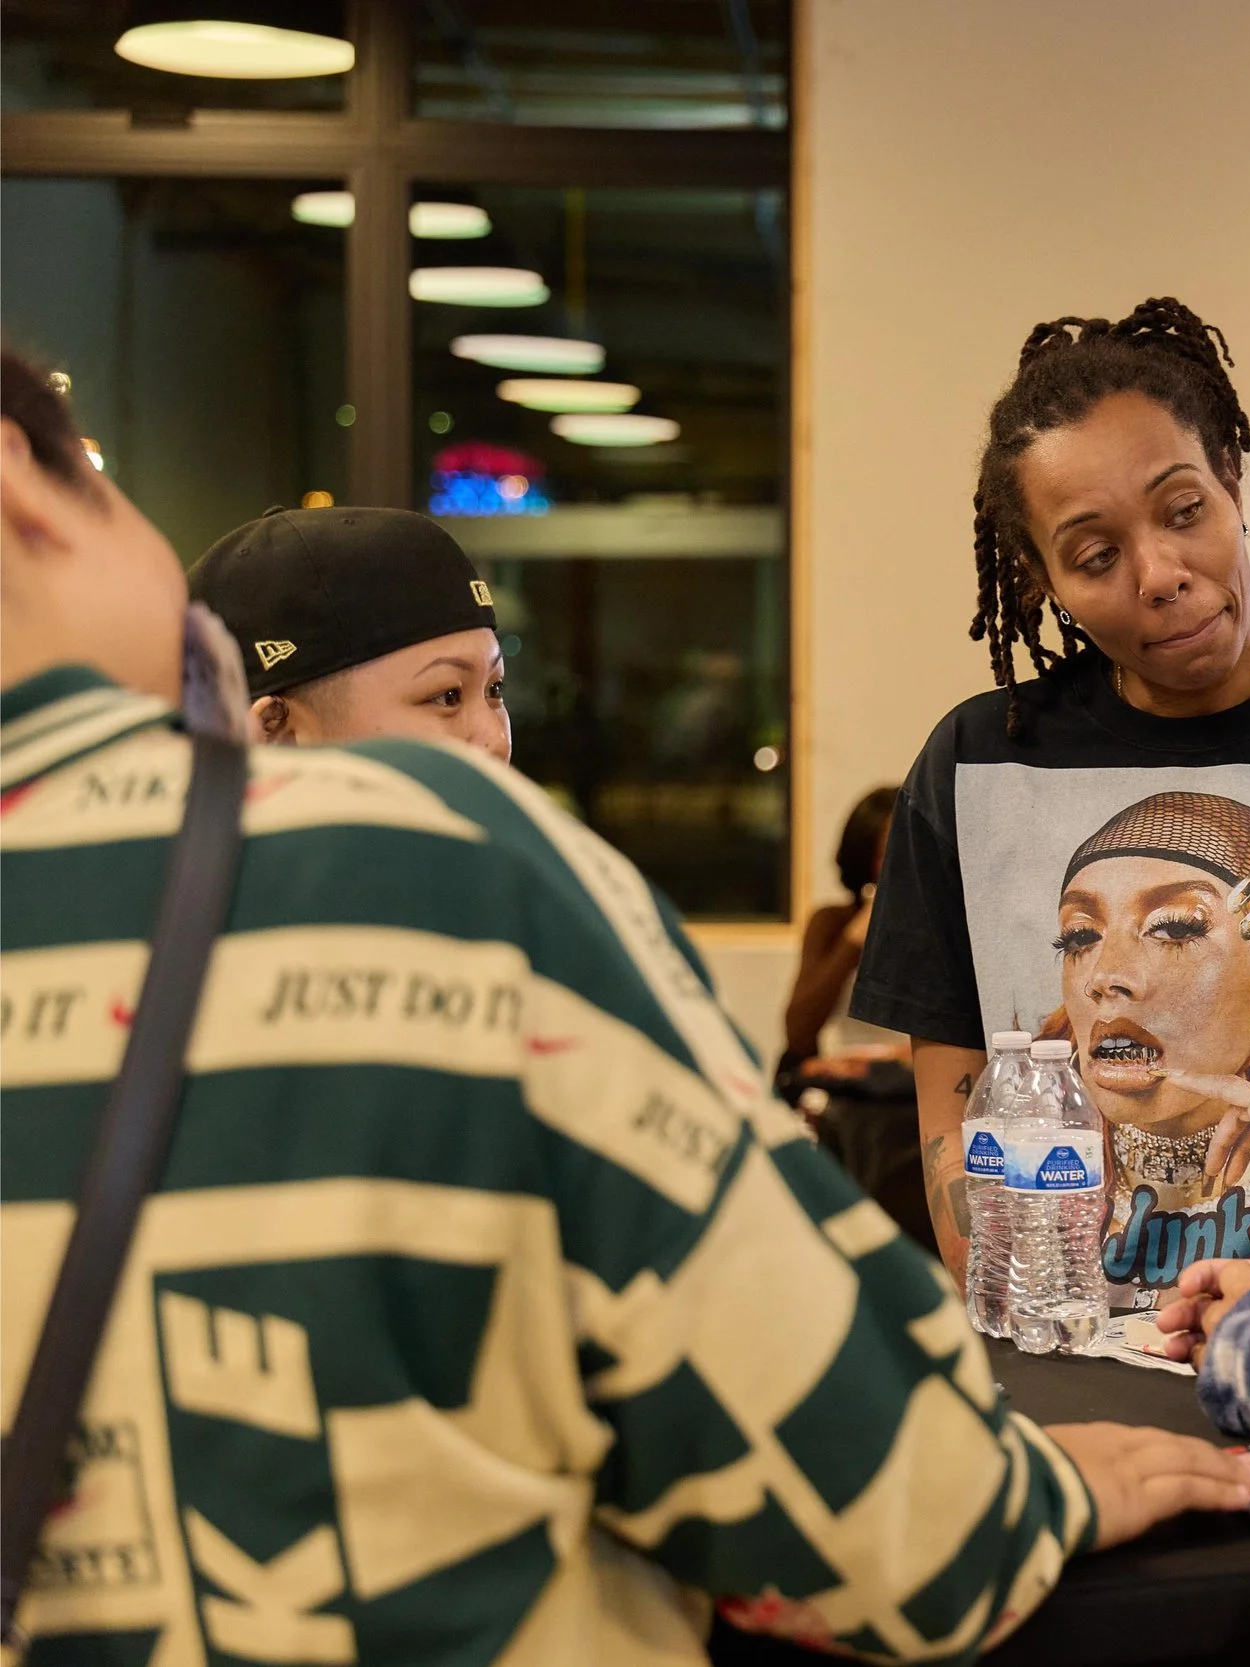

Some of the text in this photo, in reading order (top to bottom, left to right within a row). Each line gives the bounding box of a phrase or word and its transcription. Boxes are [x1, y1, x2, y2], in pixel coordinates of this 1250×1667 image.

[259, 967, 394, 1028] JUST
[400, 967, 475, 1031] DO
[969, 1153, 1004, 1167] WATER
[1040, 1170, 1086, 1182] WATER
